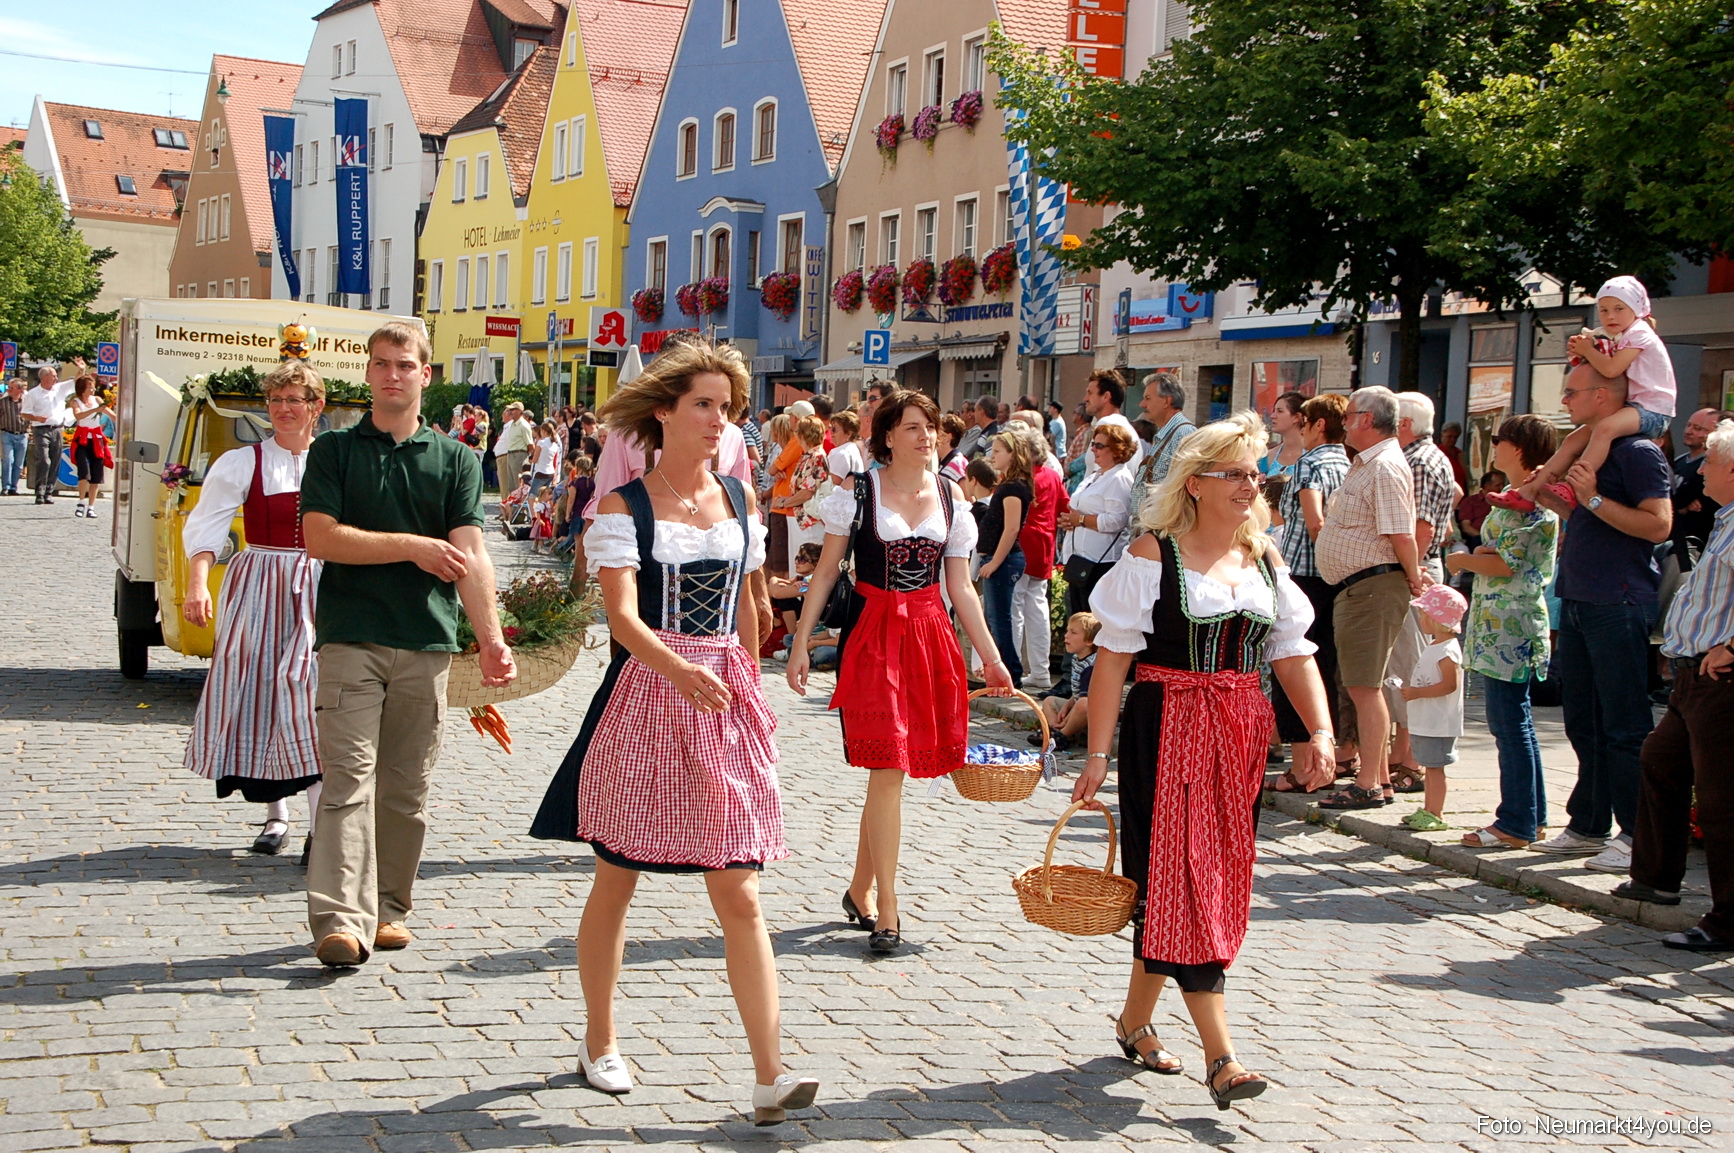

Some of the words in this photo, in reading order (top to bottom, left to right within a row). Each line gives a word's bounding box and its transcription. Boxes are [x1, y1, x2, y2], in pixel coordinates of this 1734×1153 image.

[350, 172, 362, 241] RUPPERT
[463, 226, 488, 248] HOTEL
[493, 224, 521, 243] Lehmeier
[351, 243, 363, 270] K&L
[806, 264, 820, 333] WITTL
[1082, 288, 1094, 351] KINO
[155, 325, 276, 348] Imkermeister
[457, 334, 492, 349] Restaurant
[868, 333, 885, 361] P
[157, 347, 200, 360] Bahnweg
[203, 350, 209, 359] 2
[217, 352, 243, 362] 92318
[99, 364, 117, 374] TAXI
